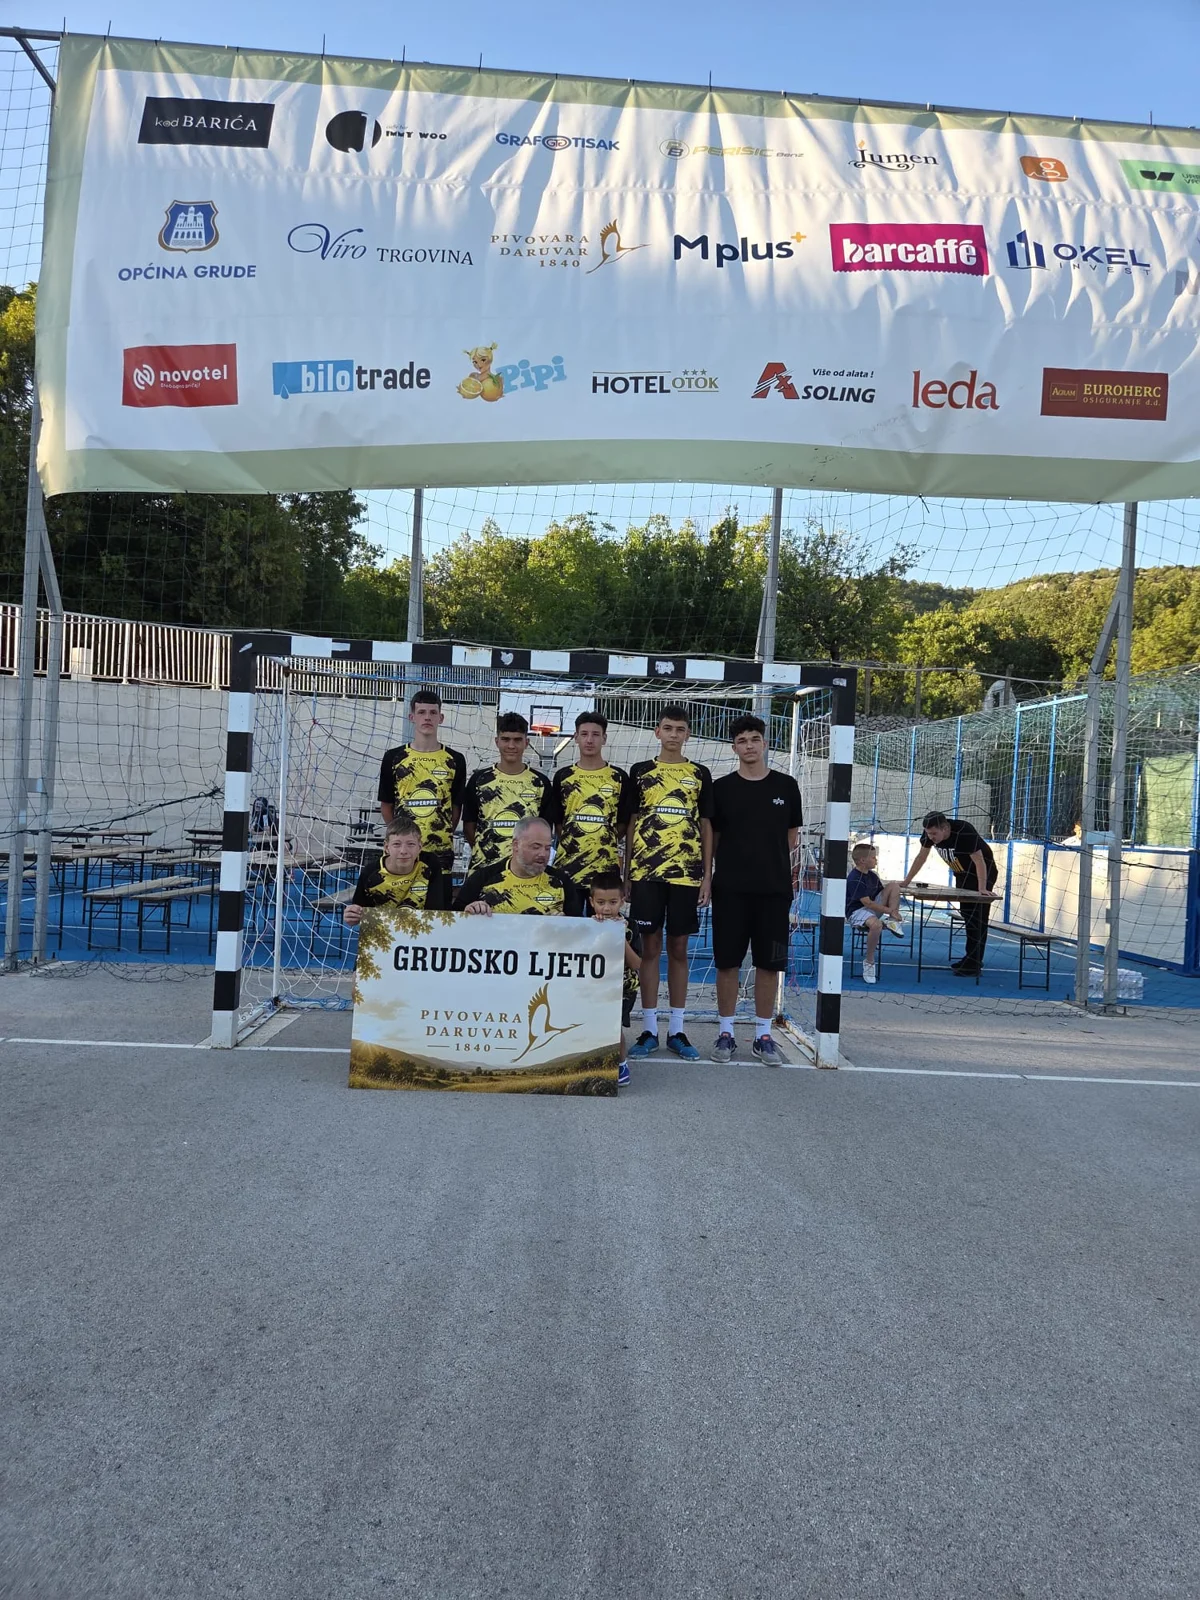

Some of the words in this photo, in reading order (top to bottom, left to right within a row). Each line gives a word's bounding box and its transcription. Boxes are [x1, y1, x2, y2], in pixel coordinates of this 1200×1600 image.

[155, 116, 180, 128] kod
[183, 115, 258, 132] BARIĆA
[418, 132, 447, 140] WOO
[287, 223, 366, 261] Viro
[376, 247, 474, 266] TRGOVINA
[490, 234, 589, 245] PIVOVARA
[500, 247, 589, 257] DARUVAR
[842, 238, 977, 266] barcaffé
[1053, 243, 1150, 268] OKEL
[118, 262, 188, 281] OPĆINA
[194, 265, 257, 279] GRUDE
[539, 259, 580, 268] 1840
[1059, 262, 1150, 276] INVEST
[160, 364, 227, 382] novotel
[301, 361, 431, 392] bilotrade
[812, 368, 831, 378] Više
[833, 369, 844, 378] od
[845, 369, 868, 378] alata
[592, 375, 671, 394] HOTEL
[672, 376, 719, 390] OTOK
[912, 370, 1000, 410] leda
[1083, 384, 1161, 398] EUROHERC
[802, 385, 876, 403] SOLING
[1083, 397, 1141, 406] OSIGURANJE
[393, 945, 519, 976] GRUDSKO
[528, 953, 606, 981] LJETO
[420, 1009, 522, 1024] PIVOVARA
[426, 1026, 518, 1039] DARUVAR
[454, 1042, 492, 1052] 1840
